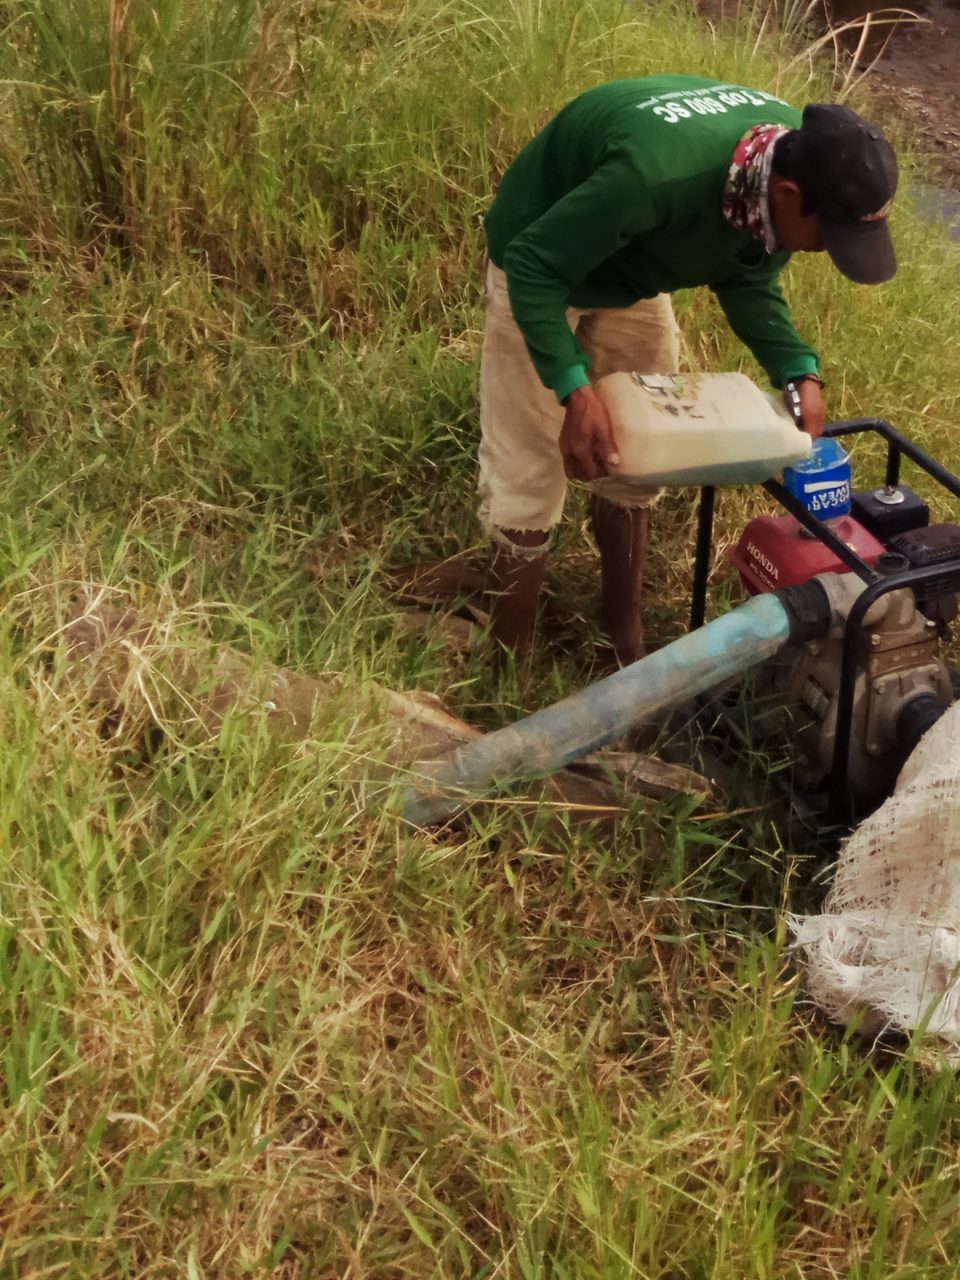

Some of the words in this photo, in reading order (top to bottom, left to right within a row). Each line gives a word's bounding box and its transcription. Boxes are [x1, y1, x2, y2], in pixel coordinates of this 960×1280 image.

[683, 96, 727, 114] 600
[717, 89, 765, 107] Top
[653, 102, 691, 123] SC
[808, 491, 849, 510] OCARI
[746, 541, 778, 580] HONDA
